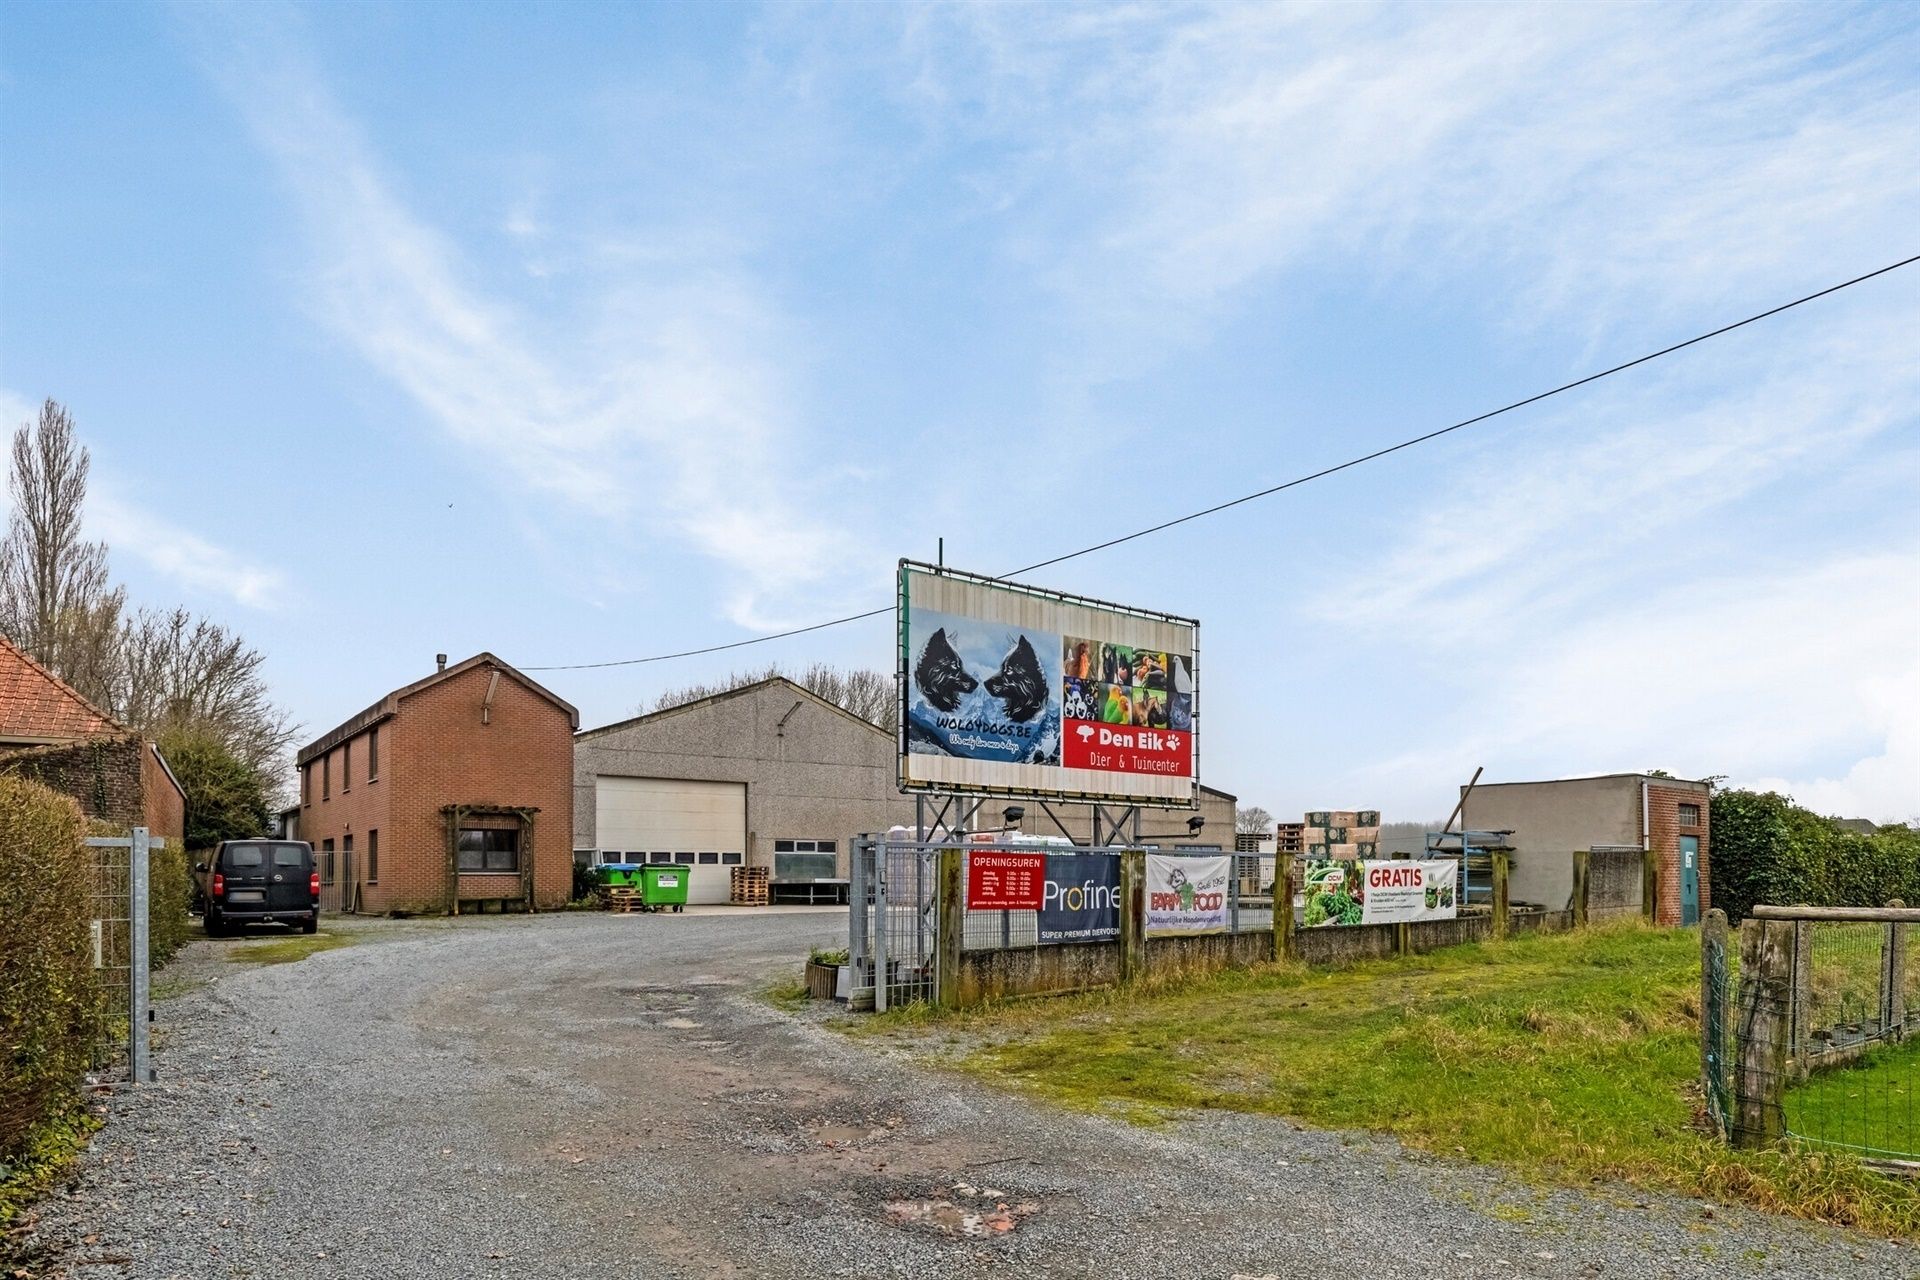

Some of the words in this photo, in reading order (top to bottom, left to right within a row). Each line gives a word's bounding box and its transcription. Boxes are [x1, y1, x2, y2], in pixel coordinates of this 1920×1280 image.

[936, 716, 1032, 738] WOLO4DOGS.BE
[949, 733, 962, 745] We
[1100, 728, 1134, 748] Den
[1138, 732, 1164, 751] Eik
[1090, 752, 1111, 767] Dier
[1119, 754, 1125, 768] &
[1132, 756, 1180, 773] Tuincenter
[974, 857, 1040, 867] OPENINGSUREN
[1370, 869, 1422, 887] GRATIS
[1042, 880, 1120, 911] Profine
[1151, 892, 1183, 911] FARM
[1192, 893, 1223, 911] FOOD
[1150, 916, 1182, 925] Natuurlijke
[1042, 931, 1063, 939] SUPER
[1064, 929, 1091, 938] PREMIUM
